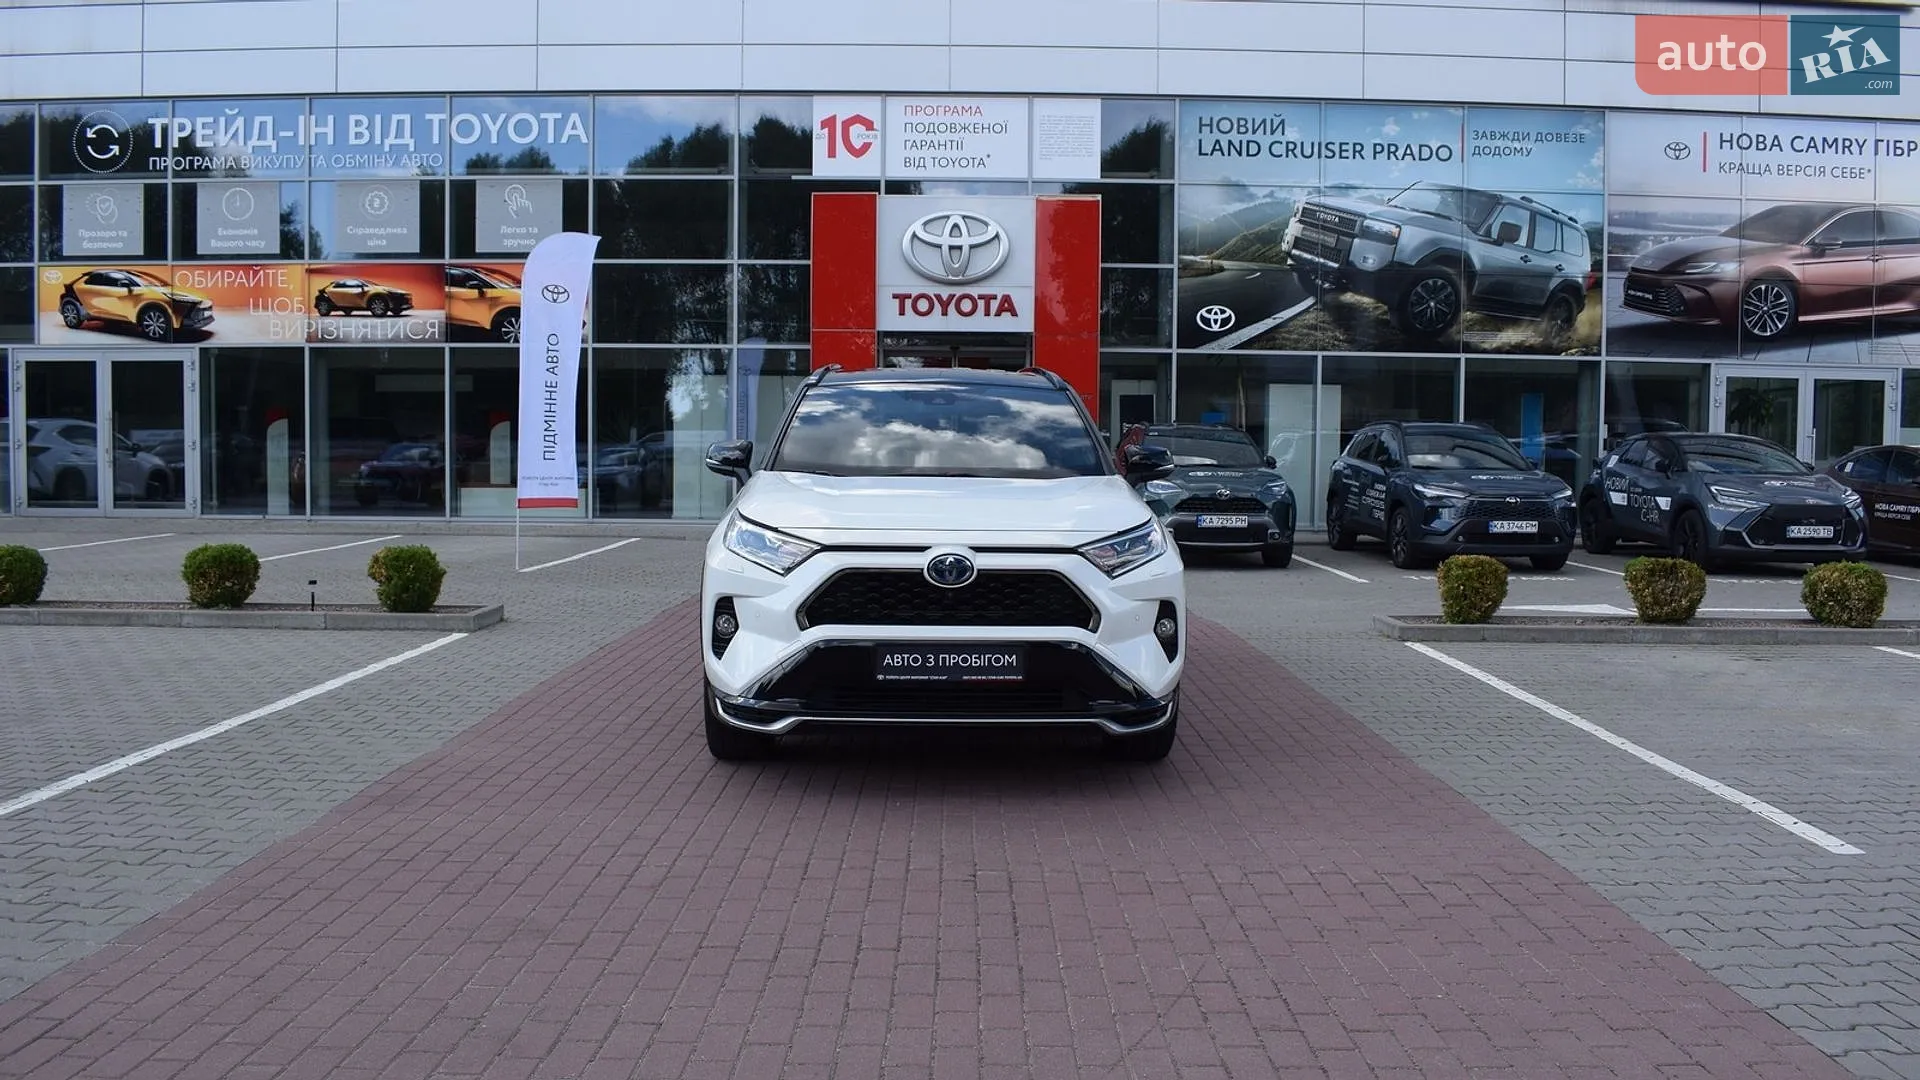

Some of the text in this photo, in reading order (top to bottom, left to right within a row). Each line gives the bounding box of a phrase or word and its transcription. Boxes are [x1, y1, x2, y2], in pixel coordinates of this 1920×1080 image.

[904, 105, 983, 117] ПРОГРАМА
[148, 108, 589, 153] ТРЕЙД-ІН ВІД TOYOTA
[904, 120, 1009, 135] ПОДОВЖЕНОЇ
[1198, 113, 1286, 136] НОВИЙ
[904, 139, 964, 151] ГАРАНТІЇ
[1472, 130, 1586, 144] ЗАВЖДИ ДОВЕЗЕ
[1719, 132, 1783, 152] НОВА
[1790, 135, 1868, 156] CAMRY
[1198, 138, 1453, 162] LAND CRUISER PRADO
[1472, 145, 1533, 158] ДОДОМУ
[149, 152, 443, 171] ПРОГРАМА ВИКУПУ ТА ОБМІНУ АВТО
[904, 156, 927, 170] ВІД
[1719, 161, 1773, 176] КРАЩА
[1777, 164, 1826, 178] ВЕРСІЯ
[1316, 212, 1340, 223] TOYOTA
[175, 265, 294, 290] ОБИРАЙТЕ,
[250, 297, 305, 316] ЩОБ
[892, 293, 1018, 317] TOYOTA
[269, 319, 439, 340] ВИРІЗНЯТИСЯ
[543, 333, 560, 461] ПІДМІННЕ АВТО
[883, 654, 1017, 667] АВТО З ПРОБІГОМ
